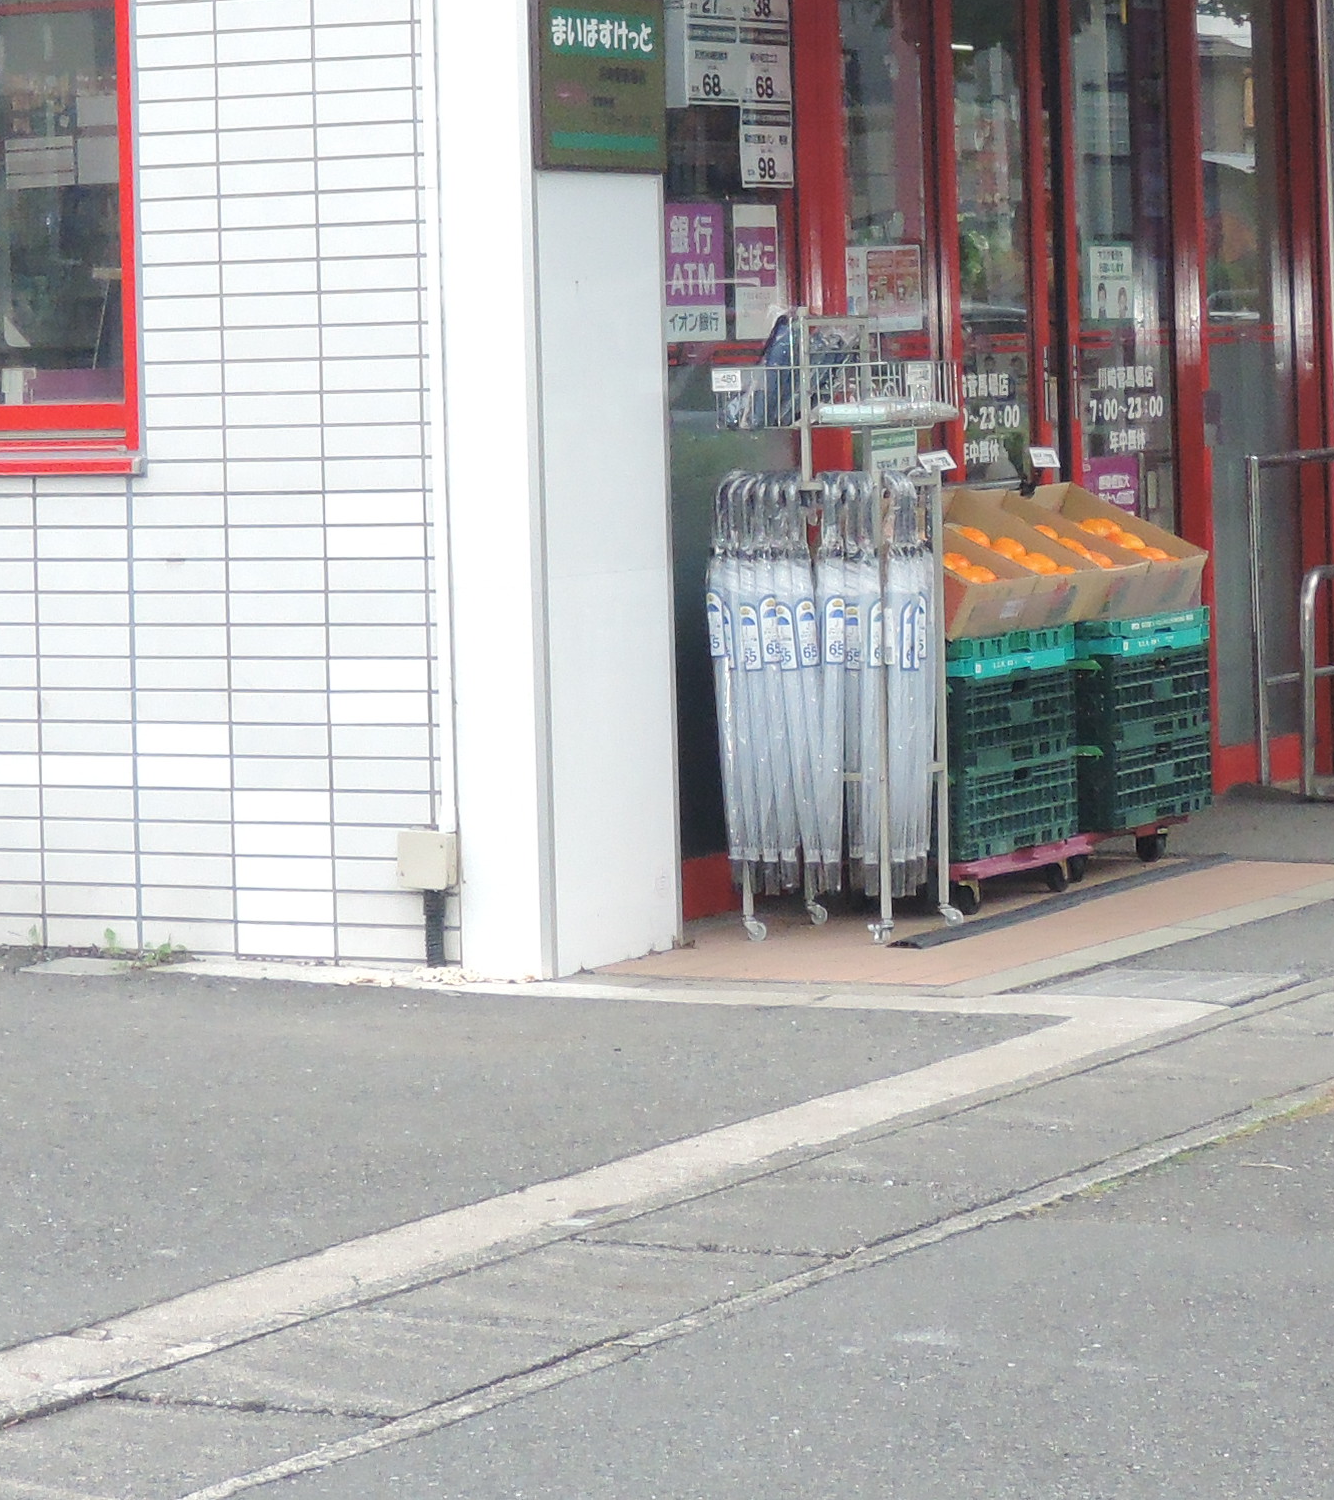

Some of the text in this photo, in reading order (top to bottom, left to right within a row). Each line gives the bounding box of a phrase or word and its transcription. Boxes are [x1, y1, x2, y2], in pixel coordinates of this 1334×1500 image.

[551, 15, 654, 53] まいばすけっと
[702, 72, 722, 97] 68
[755, 75, 774, 99] 68
[758, 157, 776, 180] 98
[669, 215, 713, 254] 銀行
[736, 241, 776, 272] たばこ
[671, 263, 717, 297] ATM
[669, 312, 719, 333] イオン銀行
